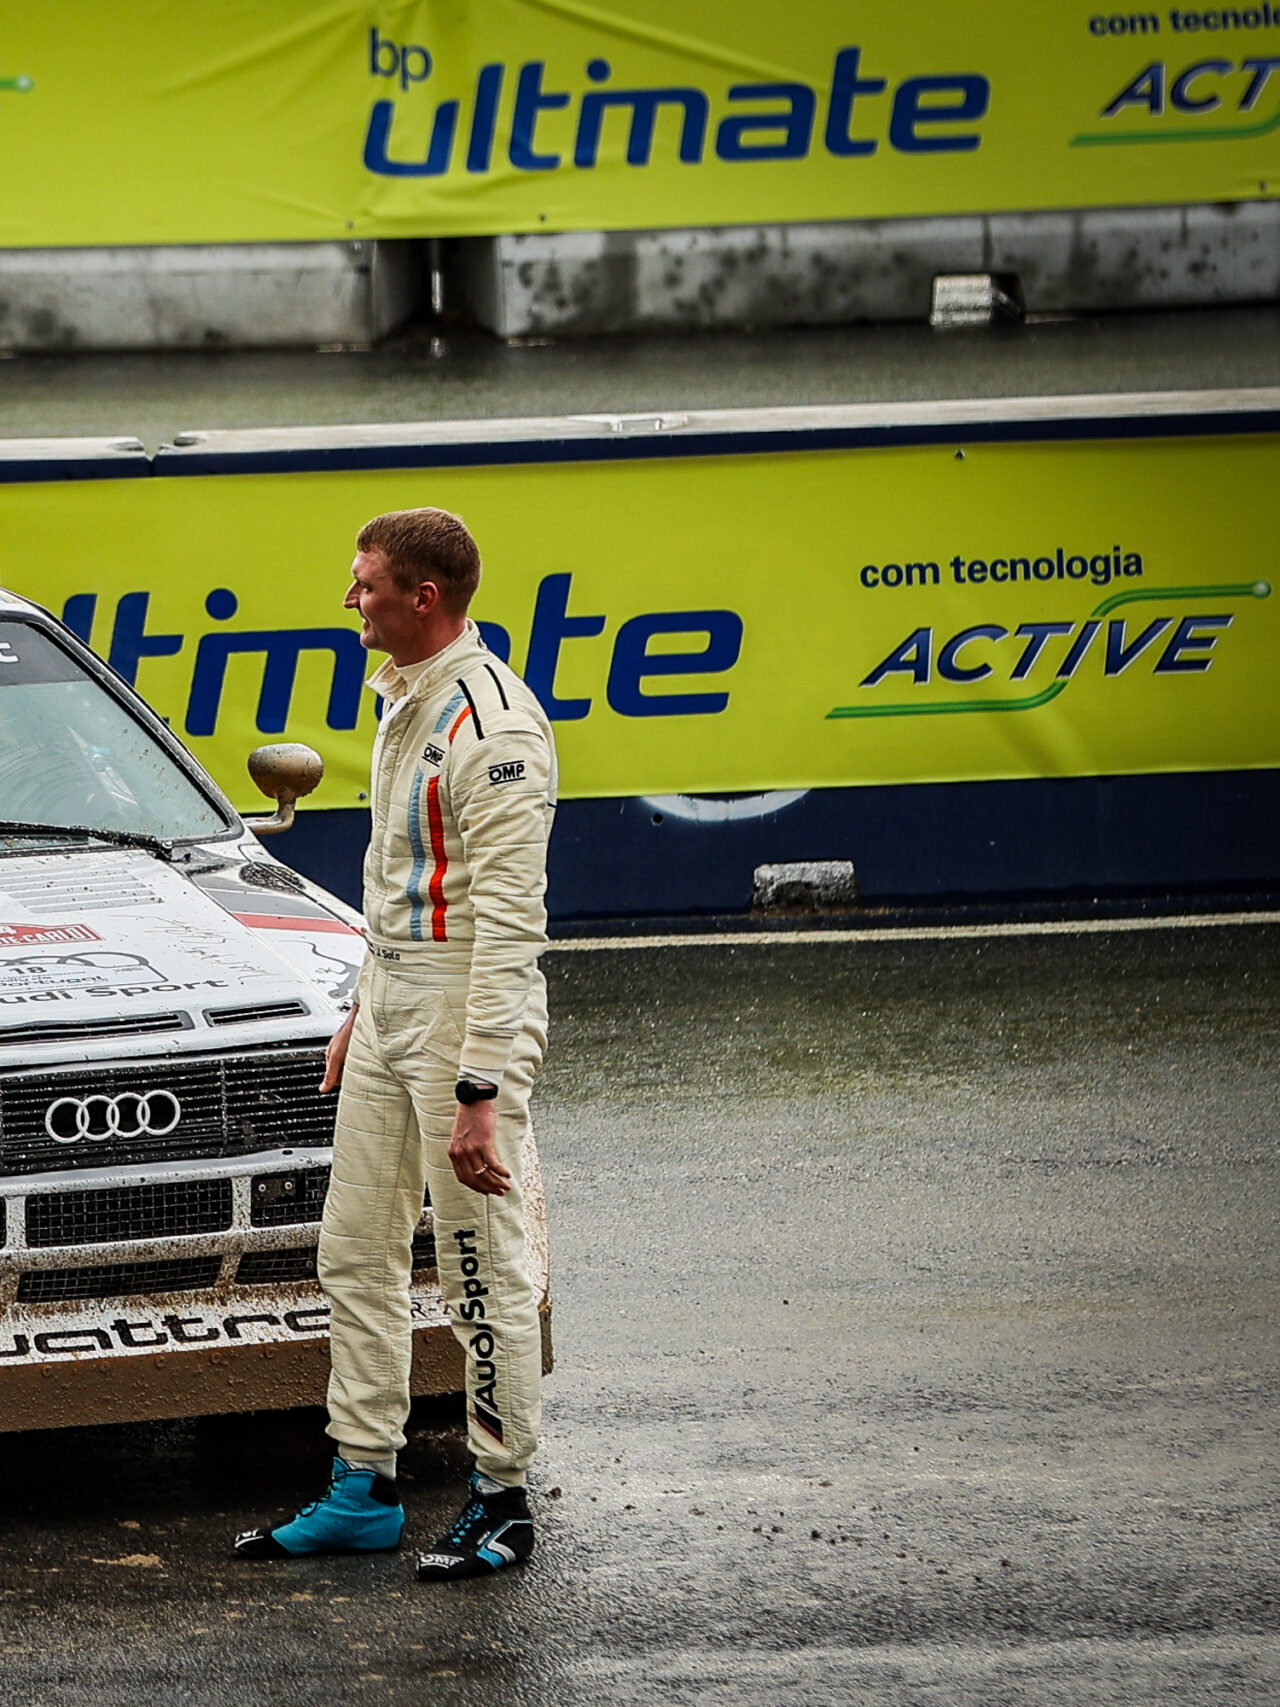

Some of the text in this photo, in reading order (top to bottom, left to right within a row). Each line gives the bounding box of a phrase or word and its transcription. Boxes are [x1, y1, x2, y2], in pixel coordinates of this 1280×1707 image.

[1089, 12, 1160, 36] com
[369, 27, 434, 91] bp
[362, 46, 990, 177] ultimate
[860, 546, 1143, 588] com tecnologia
[858, 614, 1235, 688] ACTIVE
[422, 746, 444, 764] OMP
[488, 762, 526, 782] OMP
[8, 966, 47, 975] 18
[85, 978, 231, 998] Sport
[453, 1229, 489, 1320] Sport
